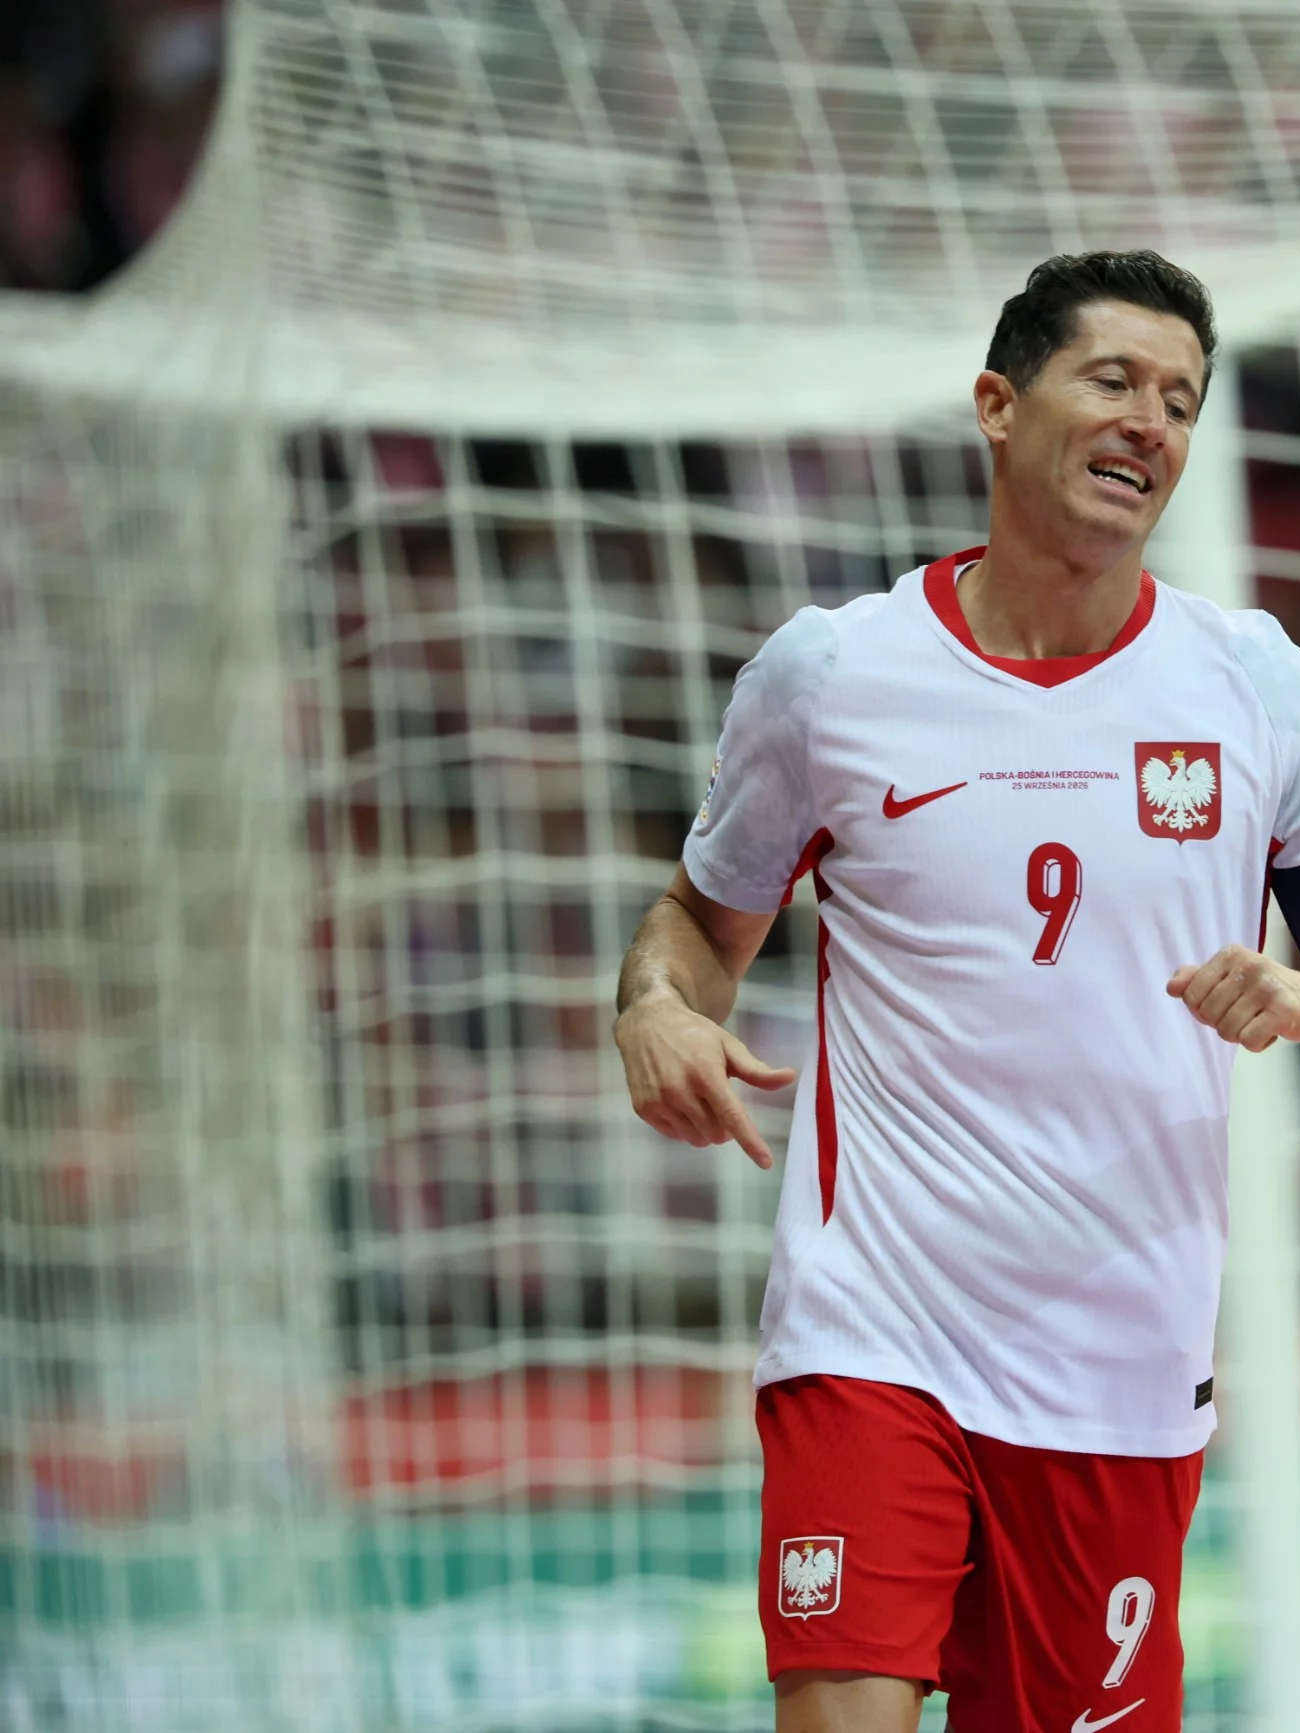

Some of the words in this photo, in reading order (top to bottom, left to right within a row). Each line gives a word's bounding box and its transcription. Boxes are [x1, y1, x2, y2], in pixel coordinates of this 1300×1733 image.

[1012, 782, 1022, 790] 25
[1024, 780, 1066, 790] WRZEŚNIA
[1067, 781, 1089, 790] 2026
[1056, 770, 1120, 780] HERCEGOWINA
[1027, 842, 1082, 965] 9
[1101, 1576, 1155, 1689] 9
